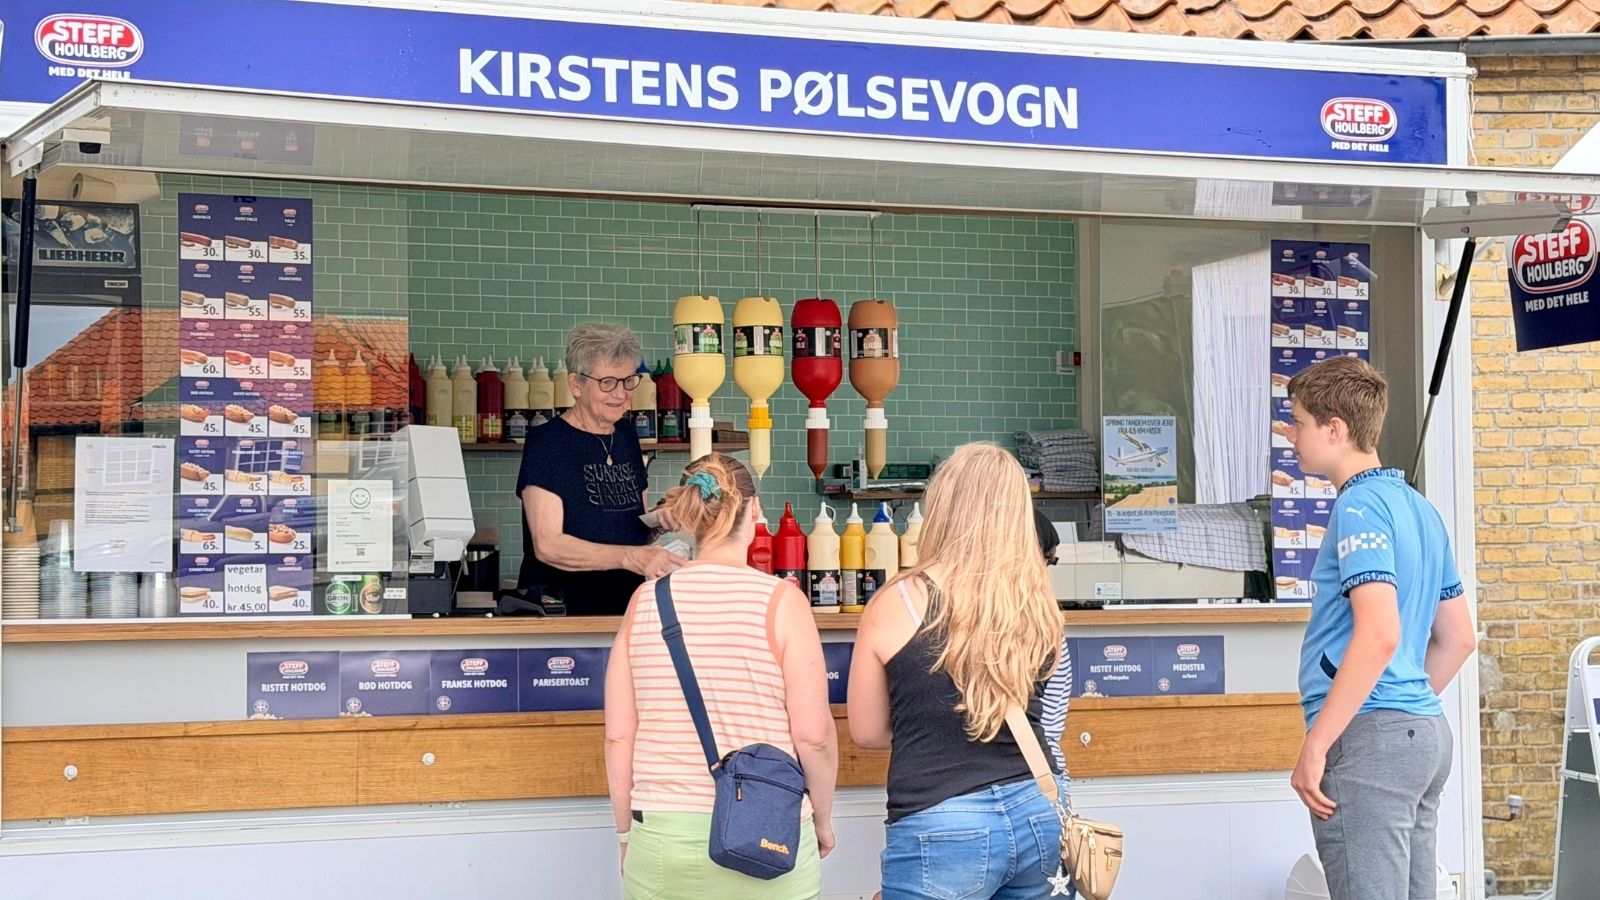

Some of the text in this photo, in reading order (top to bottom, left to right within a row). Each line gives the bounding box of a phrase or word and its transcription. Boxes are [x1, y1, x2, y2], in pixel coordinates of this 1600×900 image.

[53, 20, 125, 45] STEFF
[54, 42, 127, 60] HOULBERG
[49, 66, 131, 80] MED DET HELE
[459, 48, 1079, 130] KIRSTENS PØLSEVOGN
[1332, 103, 1385, 124] STEFF
[1334, 121, 1386, 136] HOULBERG
[1331, 141, 1390, 153] MED DET HELE
[1523, 226, 1582, 262] STEFF
[38, 249, 125, 263] LIEBHERR
[1527, 258, 1585, 284] HOULBERG
[1525, 291, 1590, 312] MED DET HELE
[227, 565, 263, 575] vegetar
[227, 583, 262, 593] hotdog
[1090, 664, 1142, 673] RISTET HOTDOG
[1172, 663, 1205, 672] MEDISTER
[261, 681, 327, 693] RISTET HOTDOG
[358, 681, 413, 691] RØD HOTDOG
[441, 679, 508, 689] FRANSK HOTDOG
[533, 677, 590, 687] PARISERTOAST
[760, 838, 790, 855] Bench.
